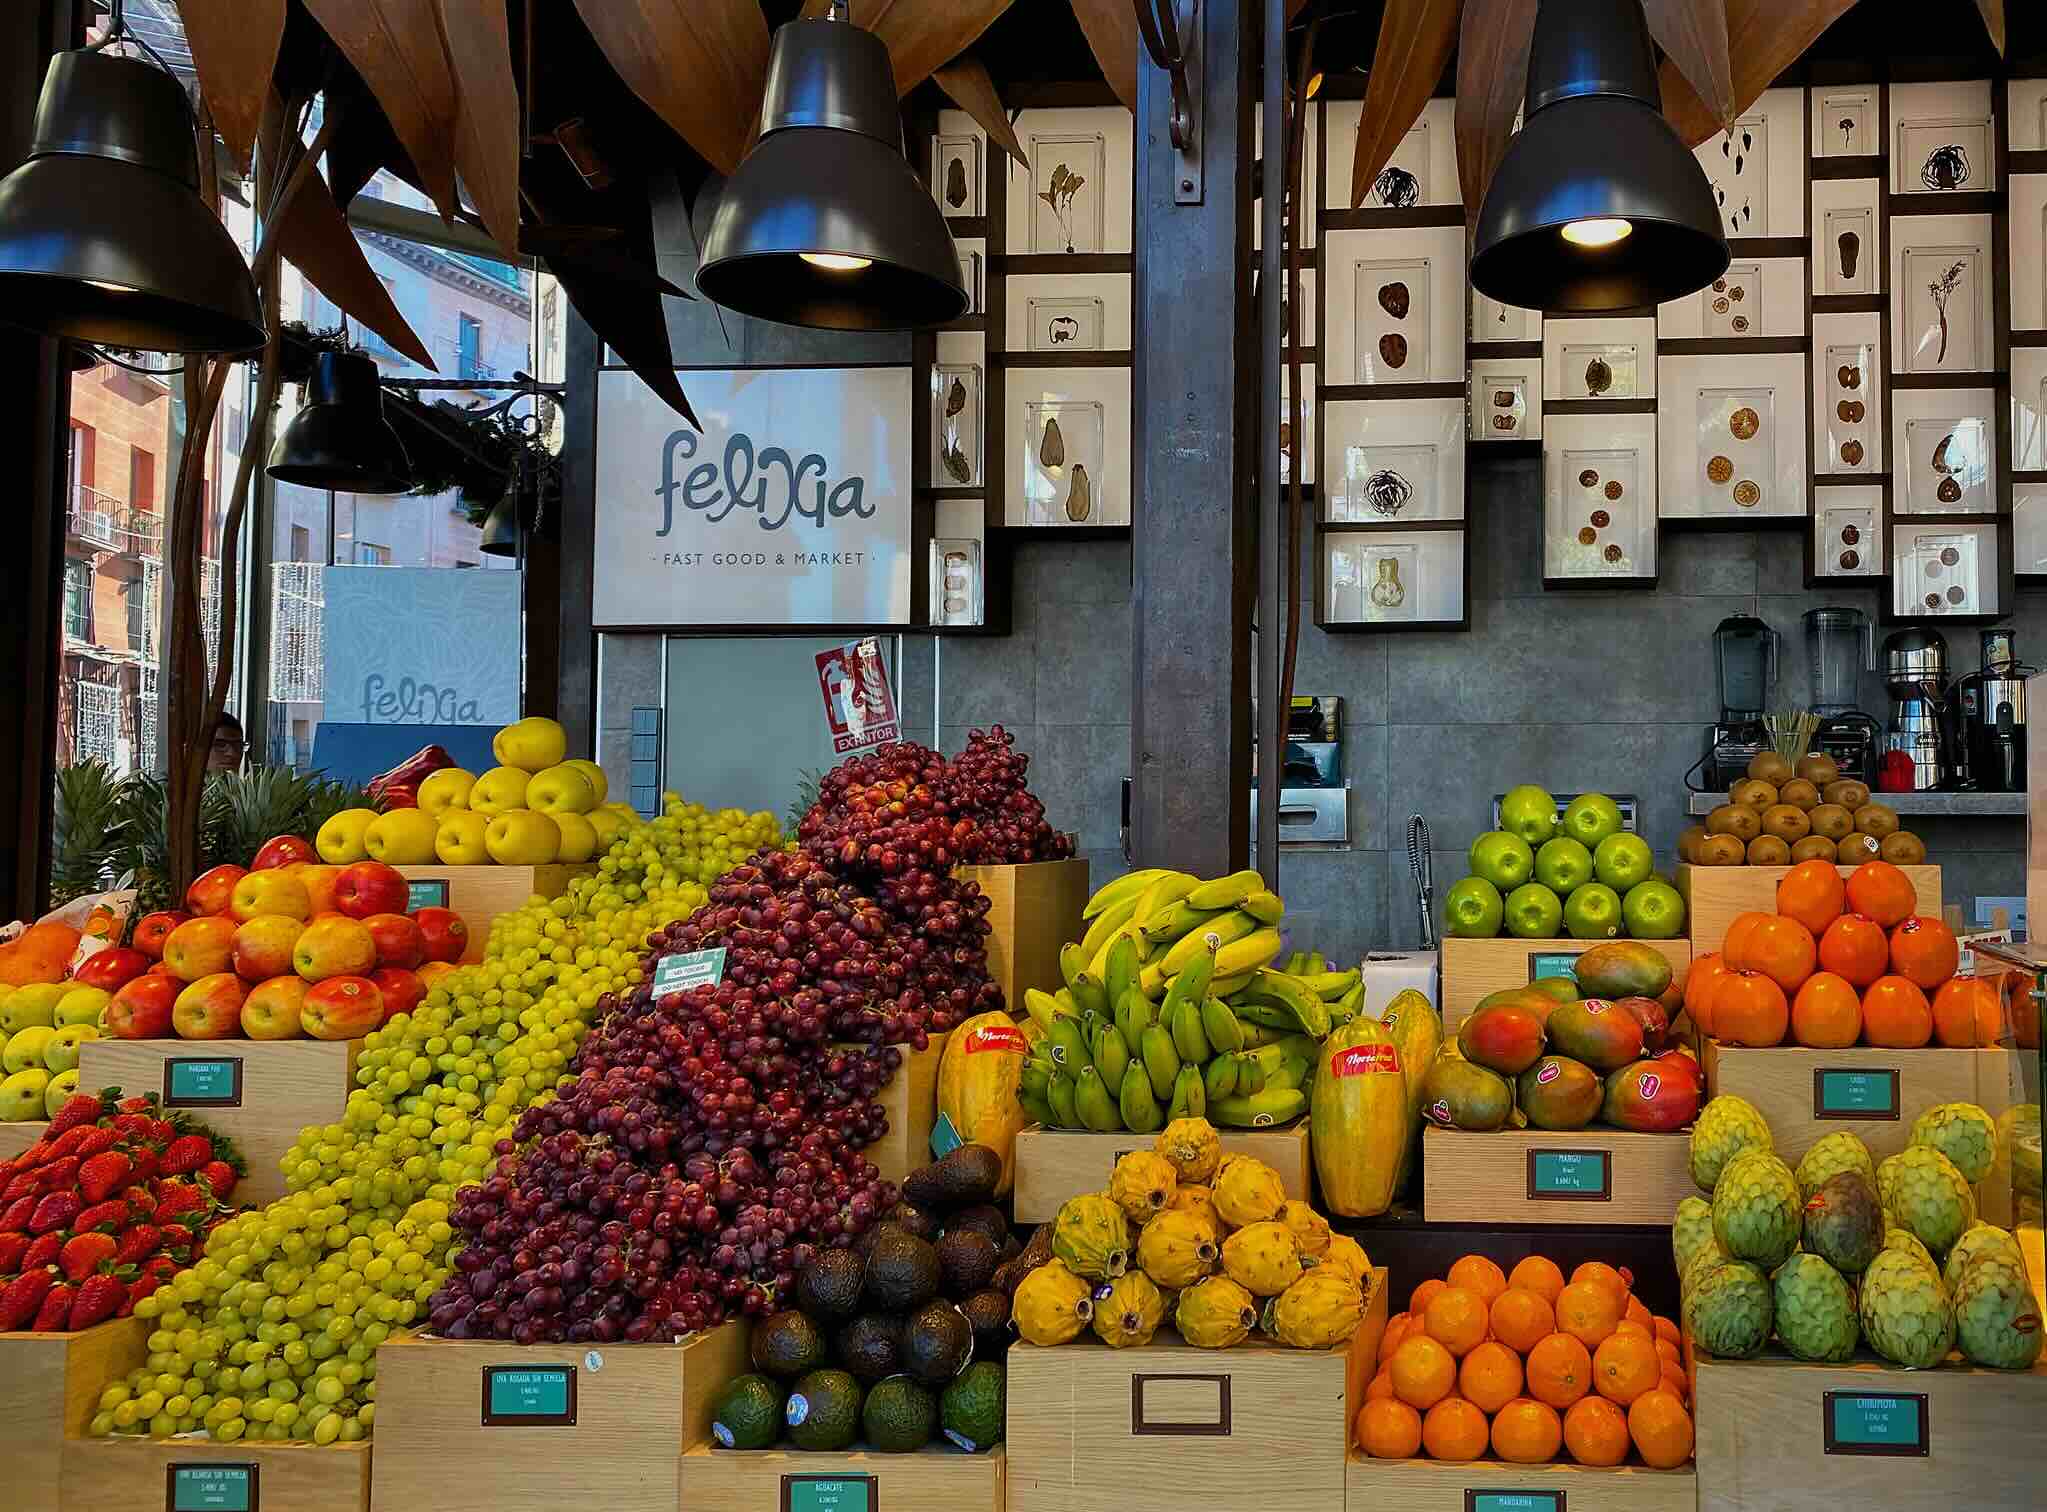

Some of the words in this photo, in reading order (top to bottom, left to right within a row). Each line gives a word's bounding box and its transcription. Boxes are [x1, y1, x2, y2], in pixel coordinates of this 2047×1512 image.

[663, 553, 704, 566] FAST
[712, 553, 766, 566] GOOD
[775, 553, 785, 566] &
[793, 552, 865, 566] MARKET
